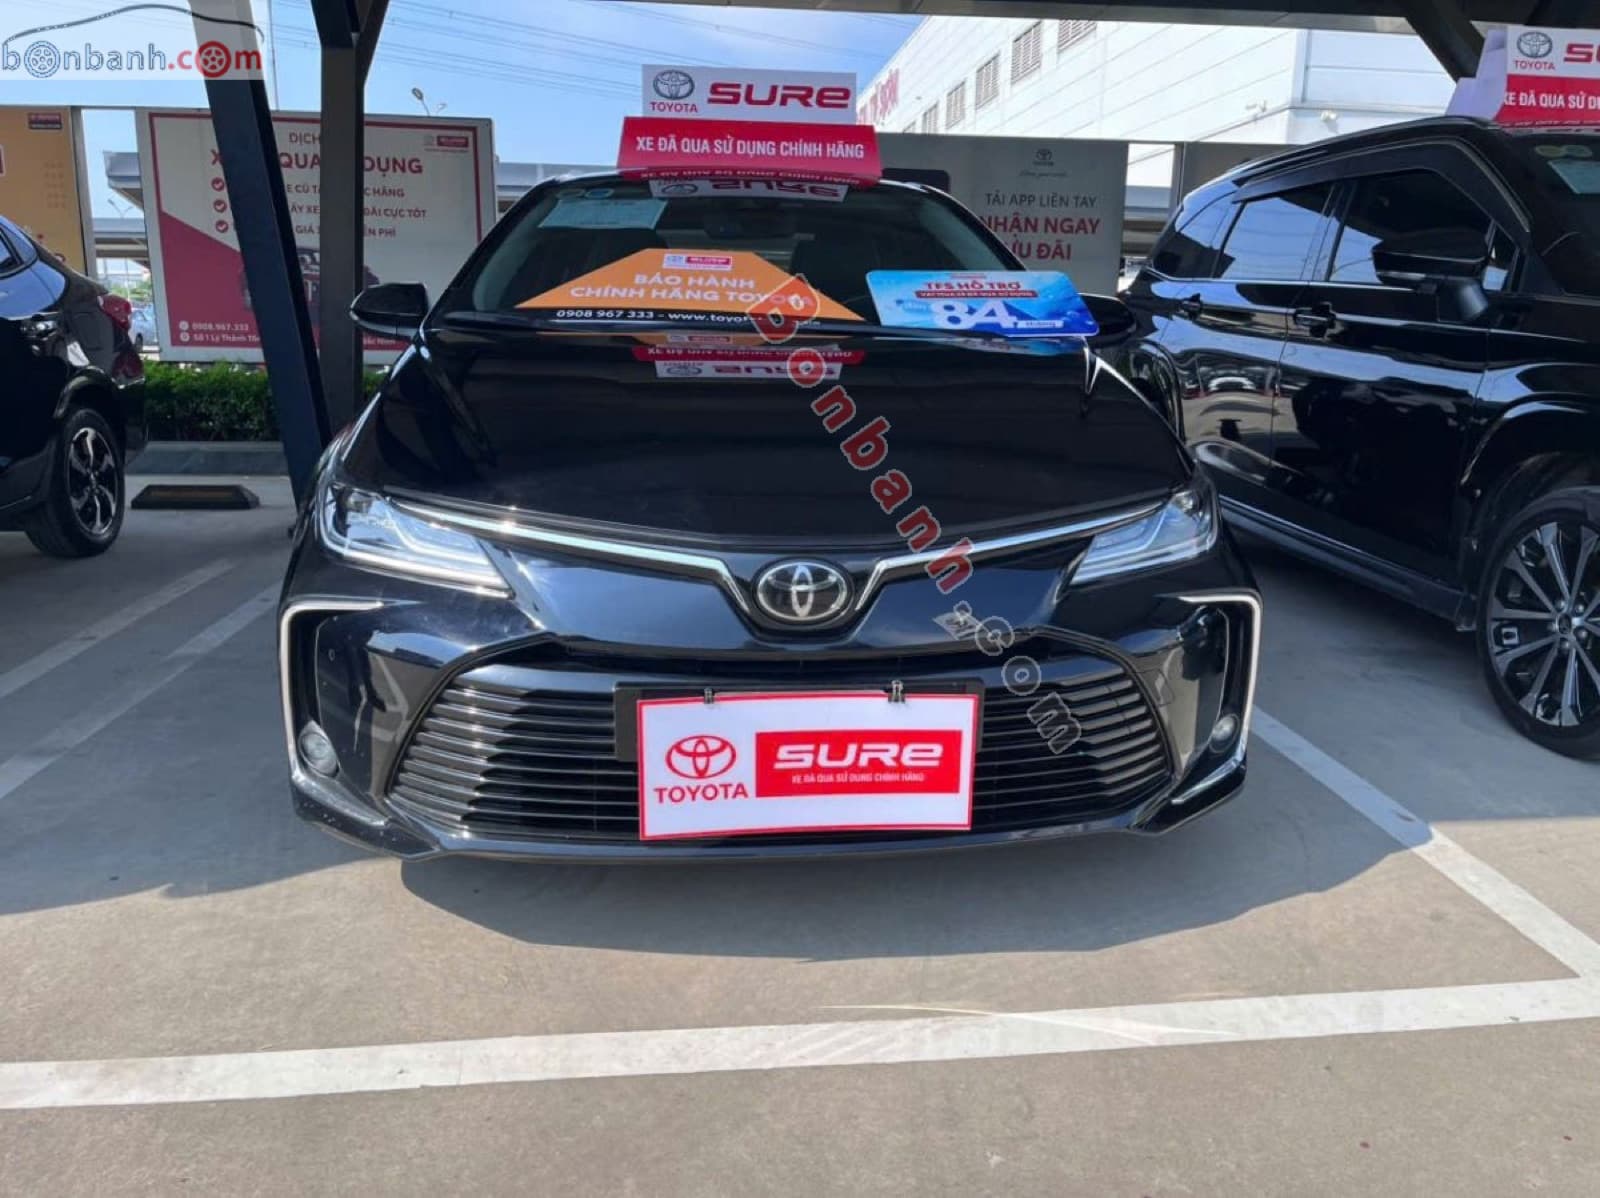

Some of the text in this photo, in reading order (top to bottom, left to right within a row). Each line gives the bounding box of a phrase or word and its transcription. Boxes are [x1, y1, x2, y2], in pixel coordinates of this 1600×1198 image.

[1514, 60, 1556, 70] TOYOTA
[650, 101, 698, 113] TOYOTA
[1519, 89, 1536, 106] ĐÃ
[1539, 94, 1565, 108] QUA
[636, 134, 864, 158] XE ĐÃ QUA SỬ DỤNG CHÍNH HÃNG
[1009, 194, 1035, 206] APP
[1073, 196, 1096, 208] TAY
[1044, 218, 1100, 234] NGAY
[1037, 240, 1071, 260] ĐÃI
[570, 286, 645, 299] CHÍNH
[556, 310, 593, 319] 0908
[597, 310, 627, 319] 967
[628, 310, 655, 320] 333
[931, 300, 1018, 330] 84
[773, 742, 944, 769] SURE
[654, 783, 748, 804] TOYOTA
